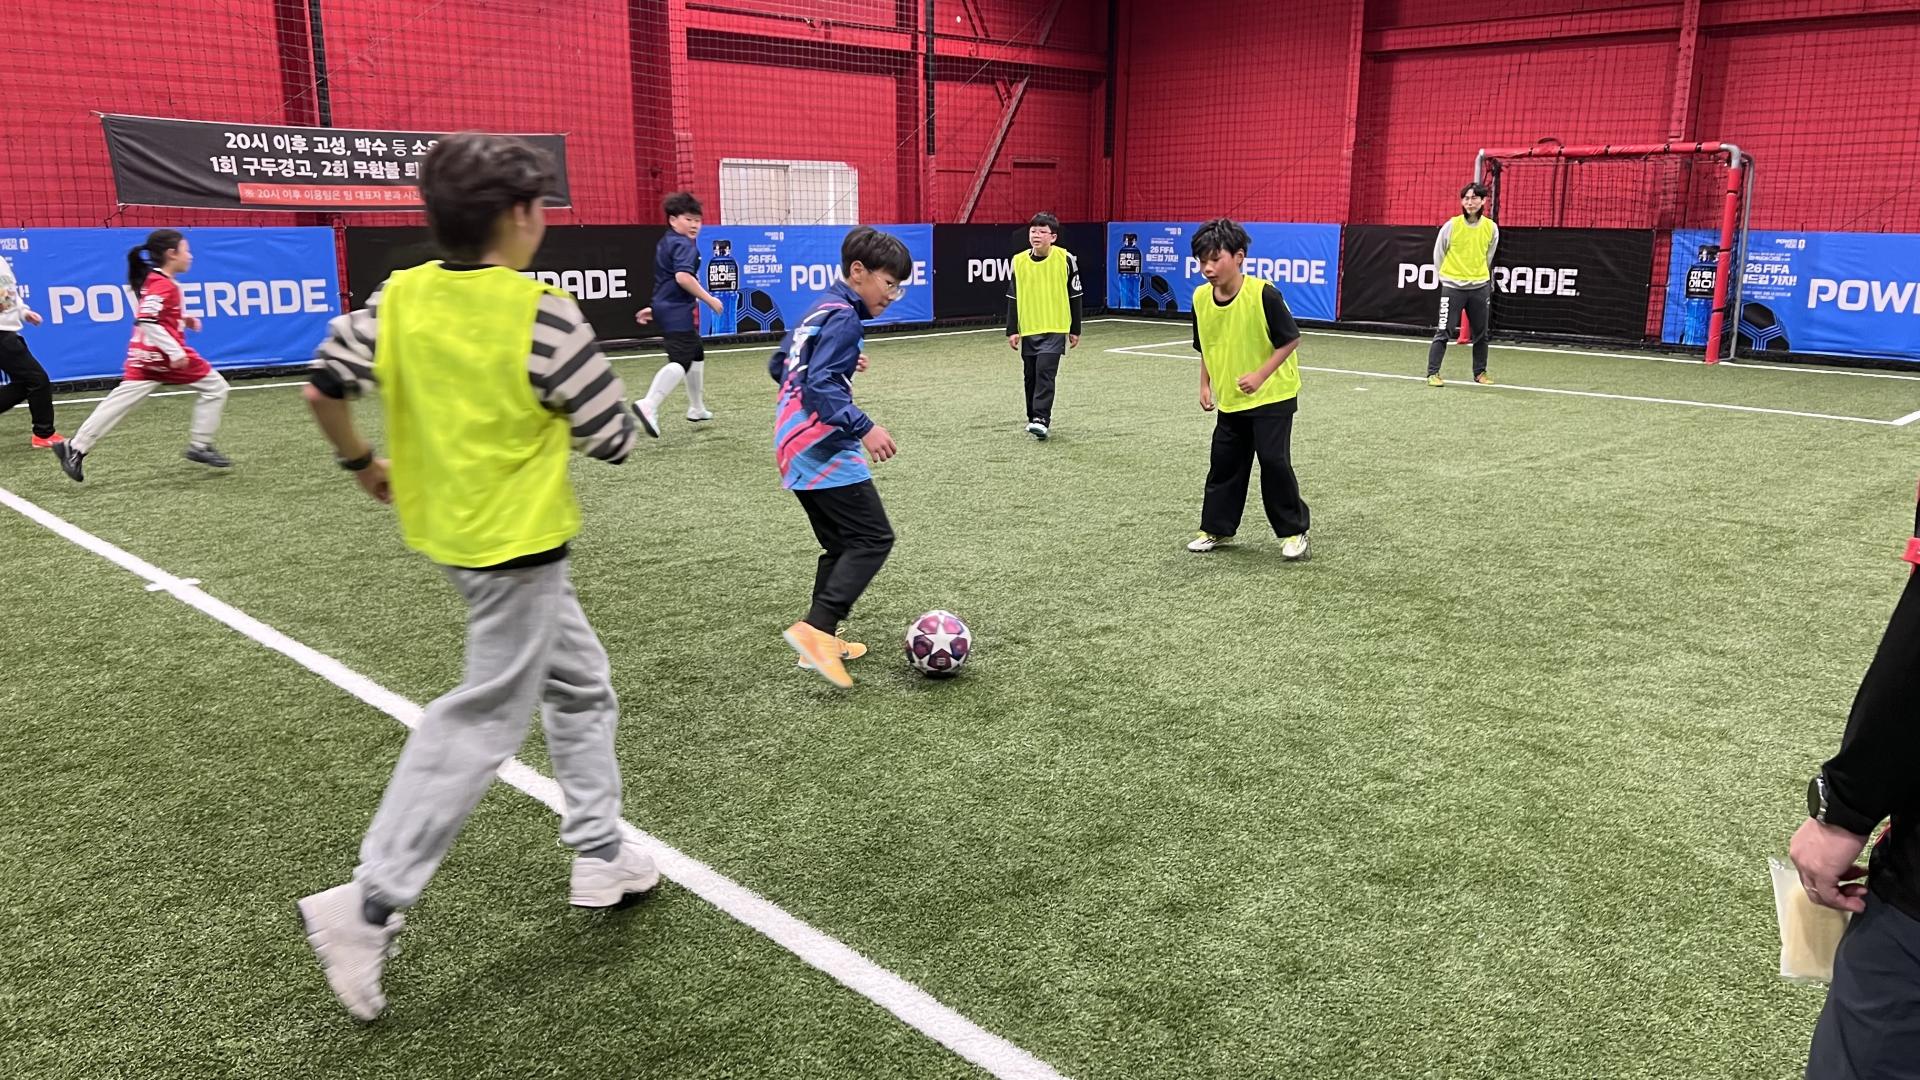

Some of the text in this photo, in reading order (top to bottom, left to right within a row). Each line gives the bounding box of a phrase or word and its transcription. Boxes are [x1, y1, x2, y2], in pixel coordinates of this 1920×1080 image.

[224, 132, 269, 153] 20시
[273, 134, 309, 154] 이후
[312, 136, 352, 156] 고성,
[354, 137, 388, 157] 박수
[392, 139, 408, 157] 등
[209, 155, 423, 180] 1회 구두경고, 2회 무환불 퇴
[258, 189, 281, 200] 20시
[283, 190, 301, 201] 이후
[760, 254, 777, 264] FIFA
[1185, 256, 1327, 285] PERADE
[1745, 263, 1790, 275] 26 FIFA
[1397, 263, 1579, 297] PORADE
[1770, 275, 1798, 286] 가자!
[1807, 278, 1920, 315] POW
[1438, 296, 1450, 330] BOSTON
